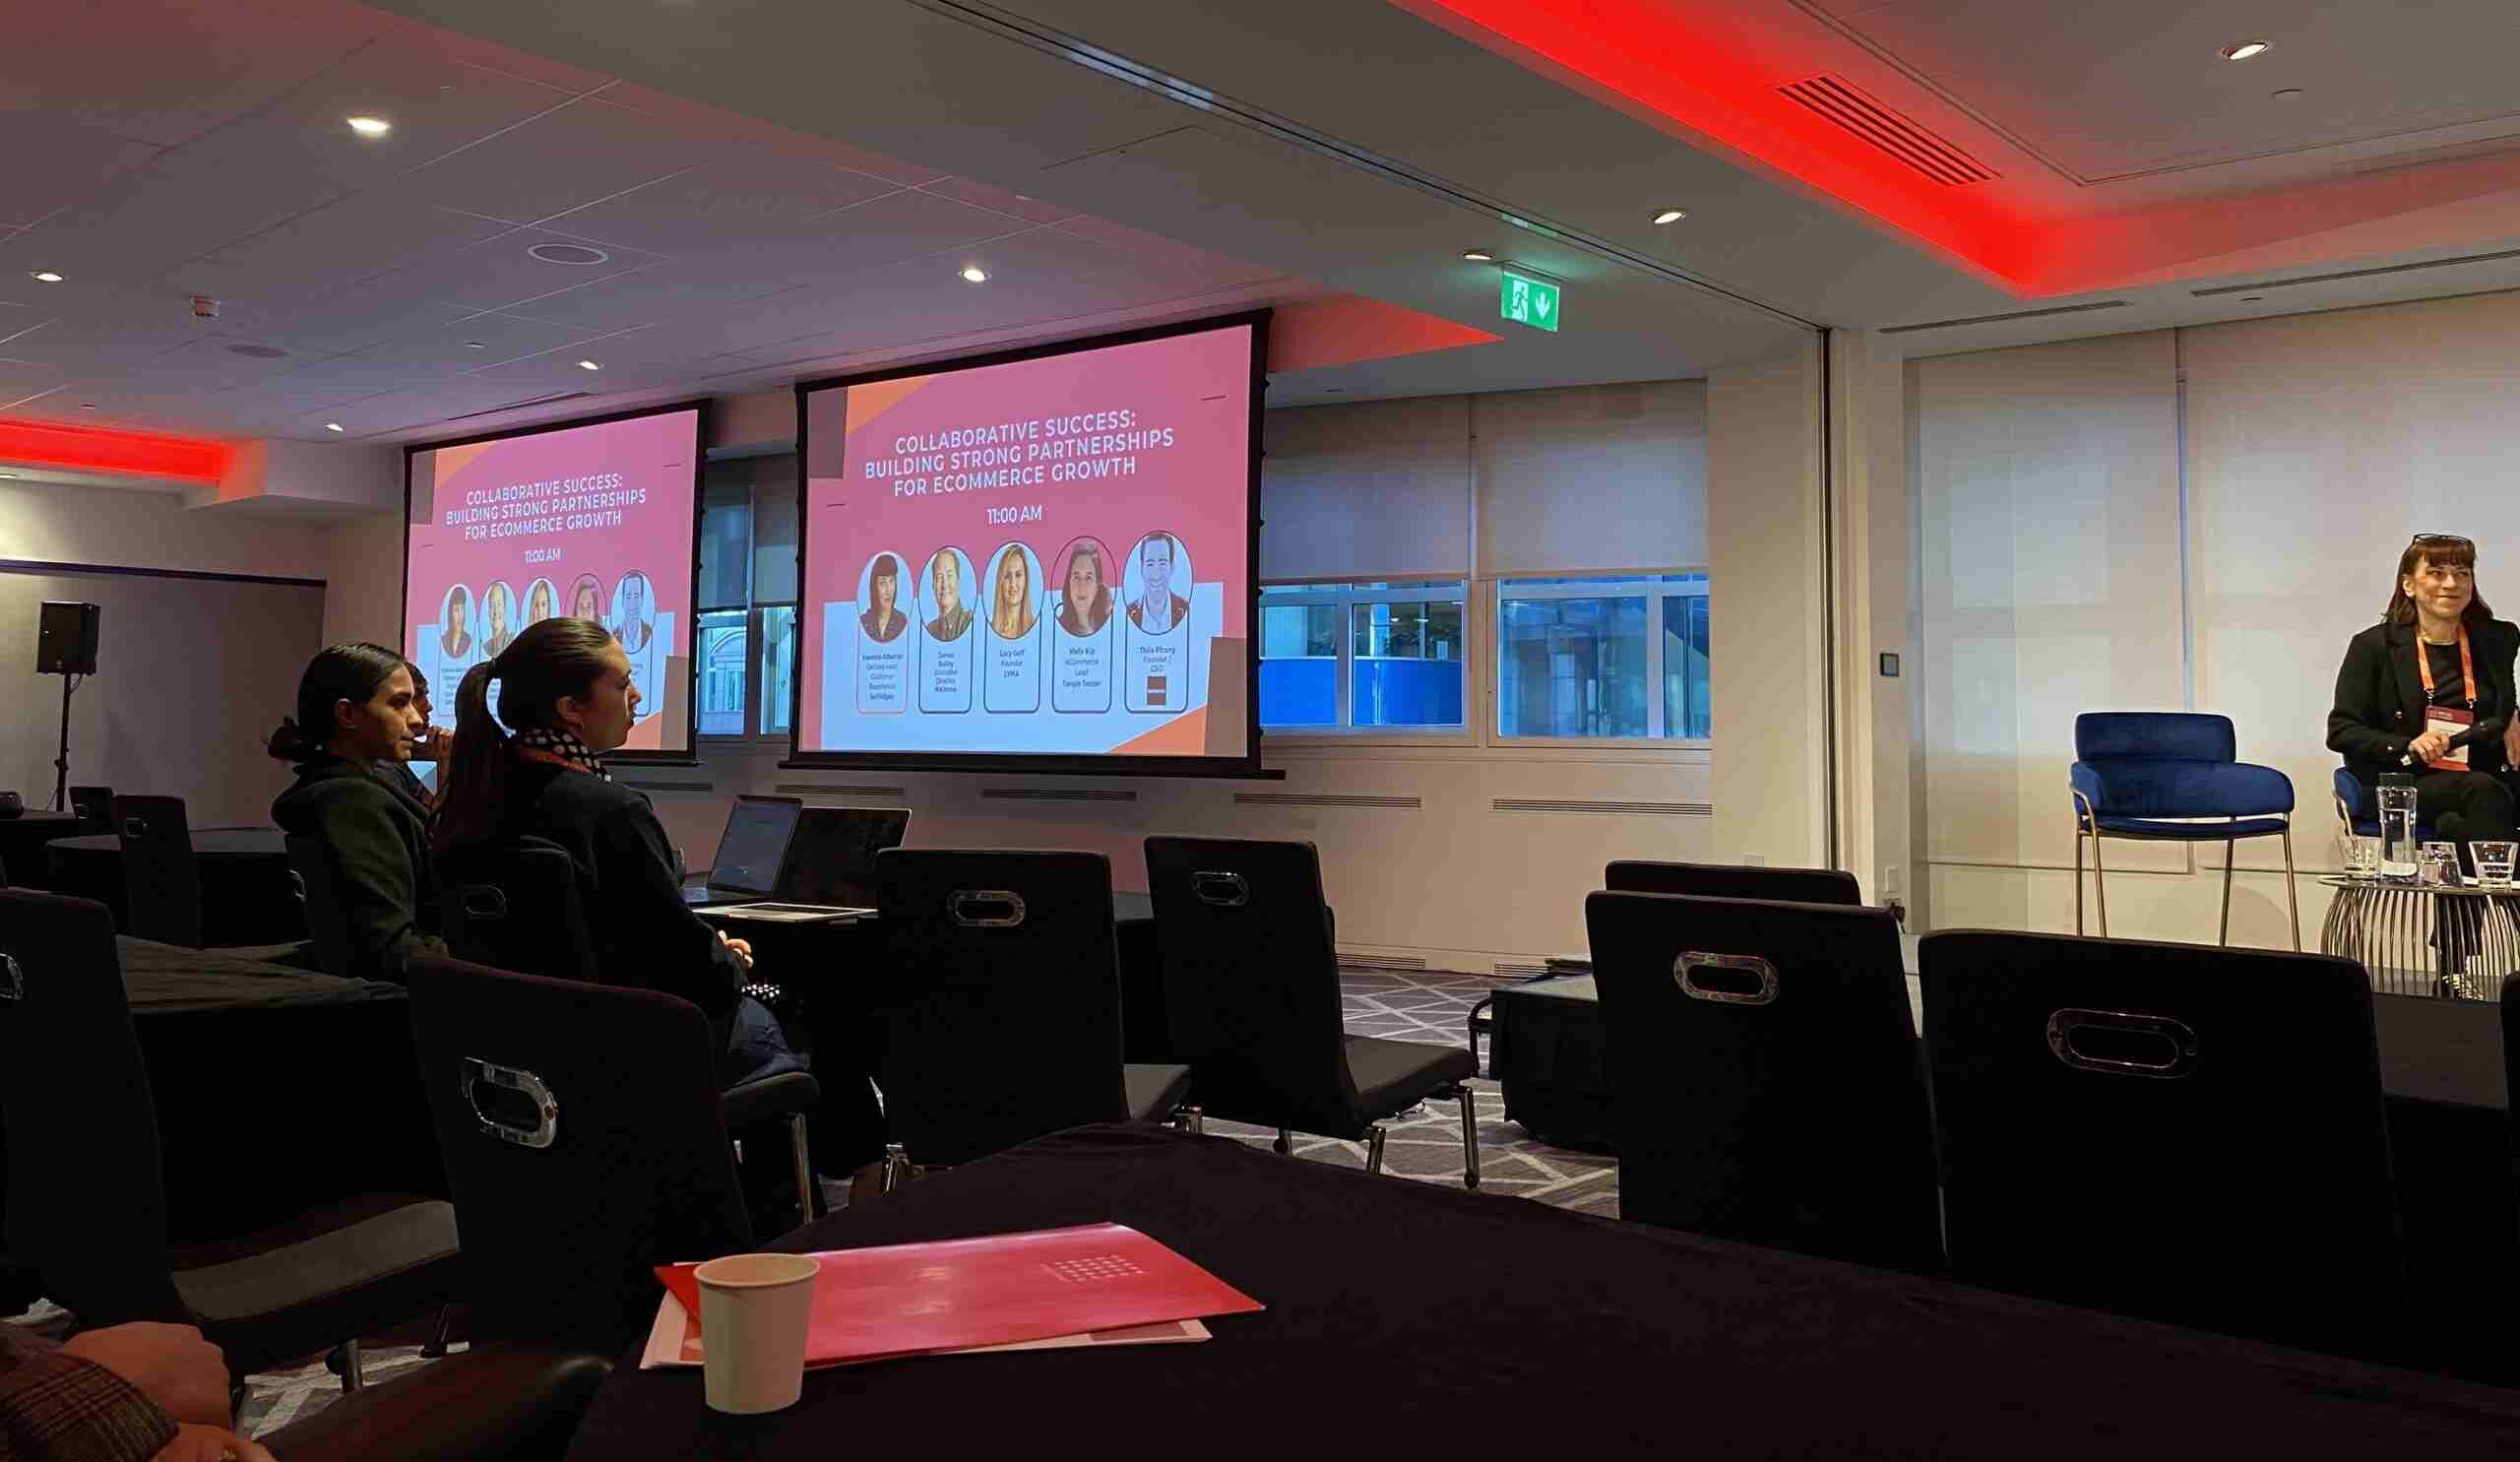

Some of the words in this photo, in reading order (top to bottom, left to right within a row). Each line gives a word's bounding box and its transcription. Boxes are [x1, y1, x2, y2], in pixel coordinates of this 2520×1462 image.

[895, 420, 1040, 454] COLLABORATIVE
[1044, 410, 1136, 437] SUCCESS:
[865, 454, 945, 479] BUILDING
[950, 445, 1021, 471] STRONG
[1028, 427, 1174, 462] PARTNERSHIPS
[466, 480, 559, 505] COLLABORATIVE
[563, 473, 622, 493] SUCCESS:
[894, 477, 927, 496] FOR
[934, 466, 1044, 493] ECOMMERCE
[1051, 456, 1136, 481] GROWTH
[446, 505, 498, 525] BUILDING
[502, 500, 547, 519] STRONG
[552, 488, 646, 512] PARTNERSHIPS
[465, 525, 487, 540] FOR
[490, 516, 563, 538] ECOMMERCE
[566, 510, 621, 530] GROWTH
[986, 506, 1017, 525] 11:00
[1020, 504, 1042, 522] AM
